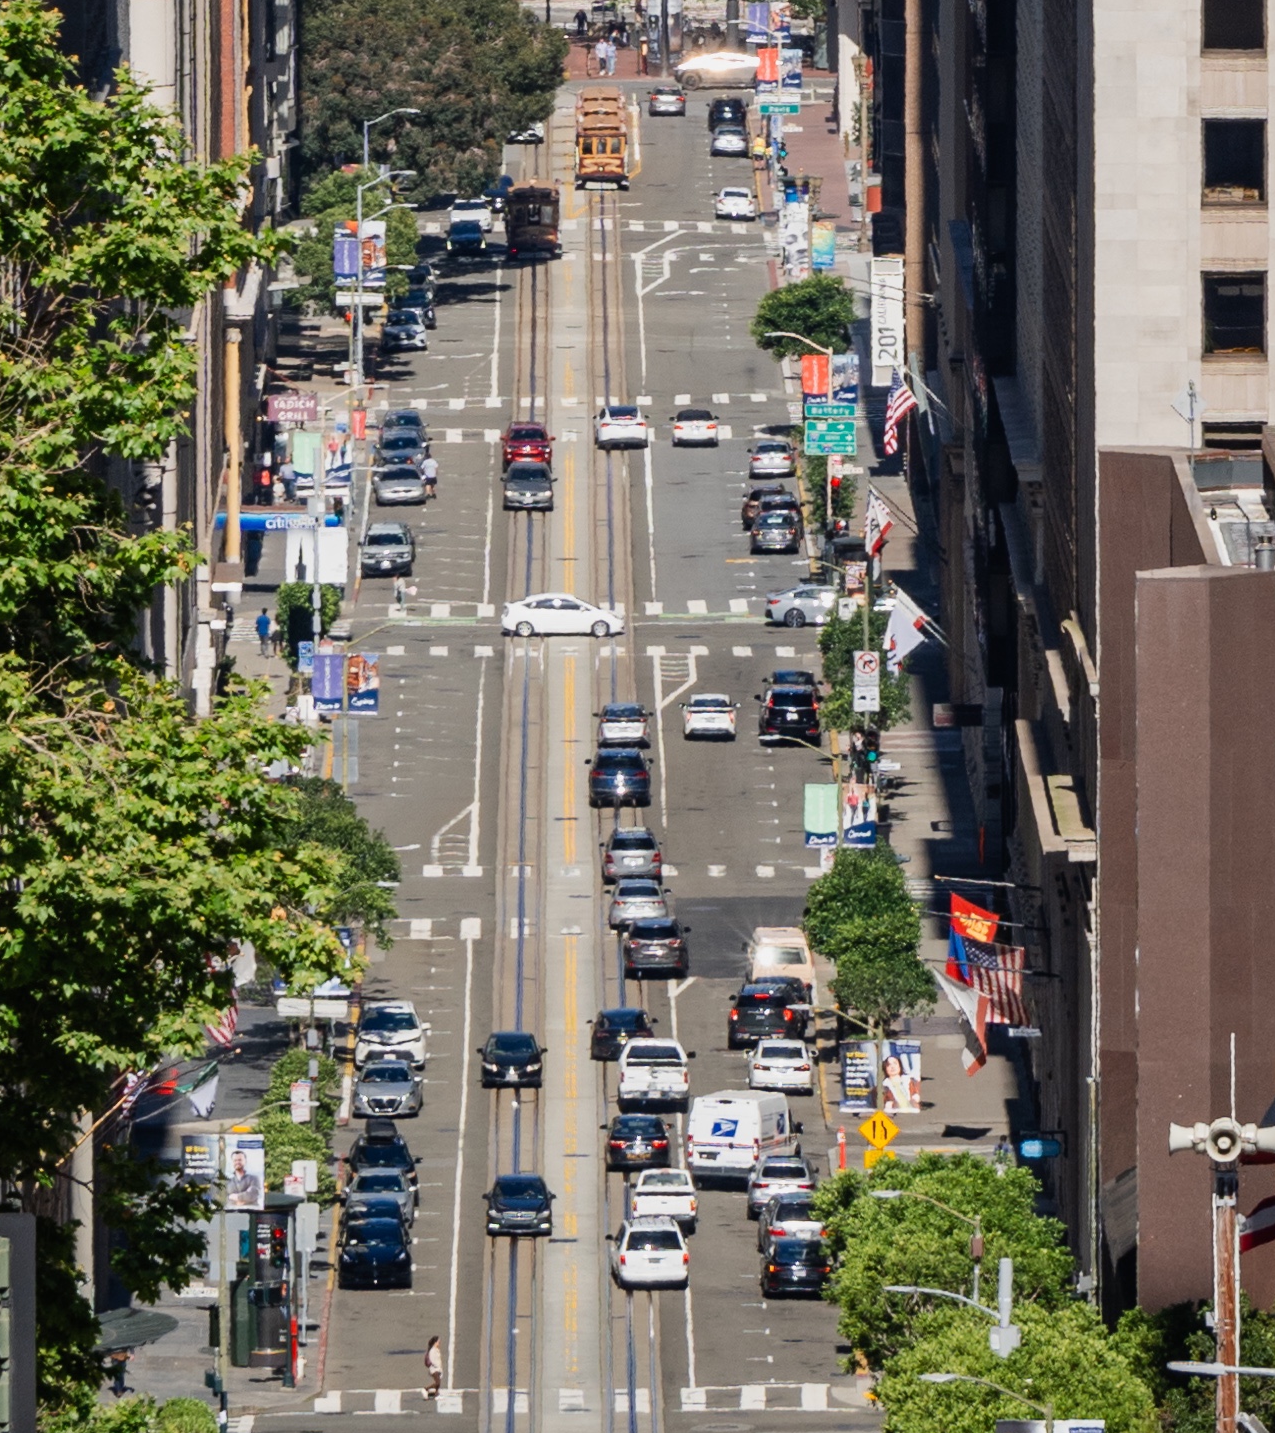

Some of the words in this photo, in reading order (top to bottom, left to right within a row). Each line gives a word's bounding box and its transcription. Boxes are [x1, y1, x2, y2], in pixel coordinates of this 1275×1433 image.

[878, 327, 897, 360] 201
[274, 400, 315, 409] TADICH
[278, 411, 309, 420] GRILL
